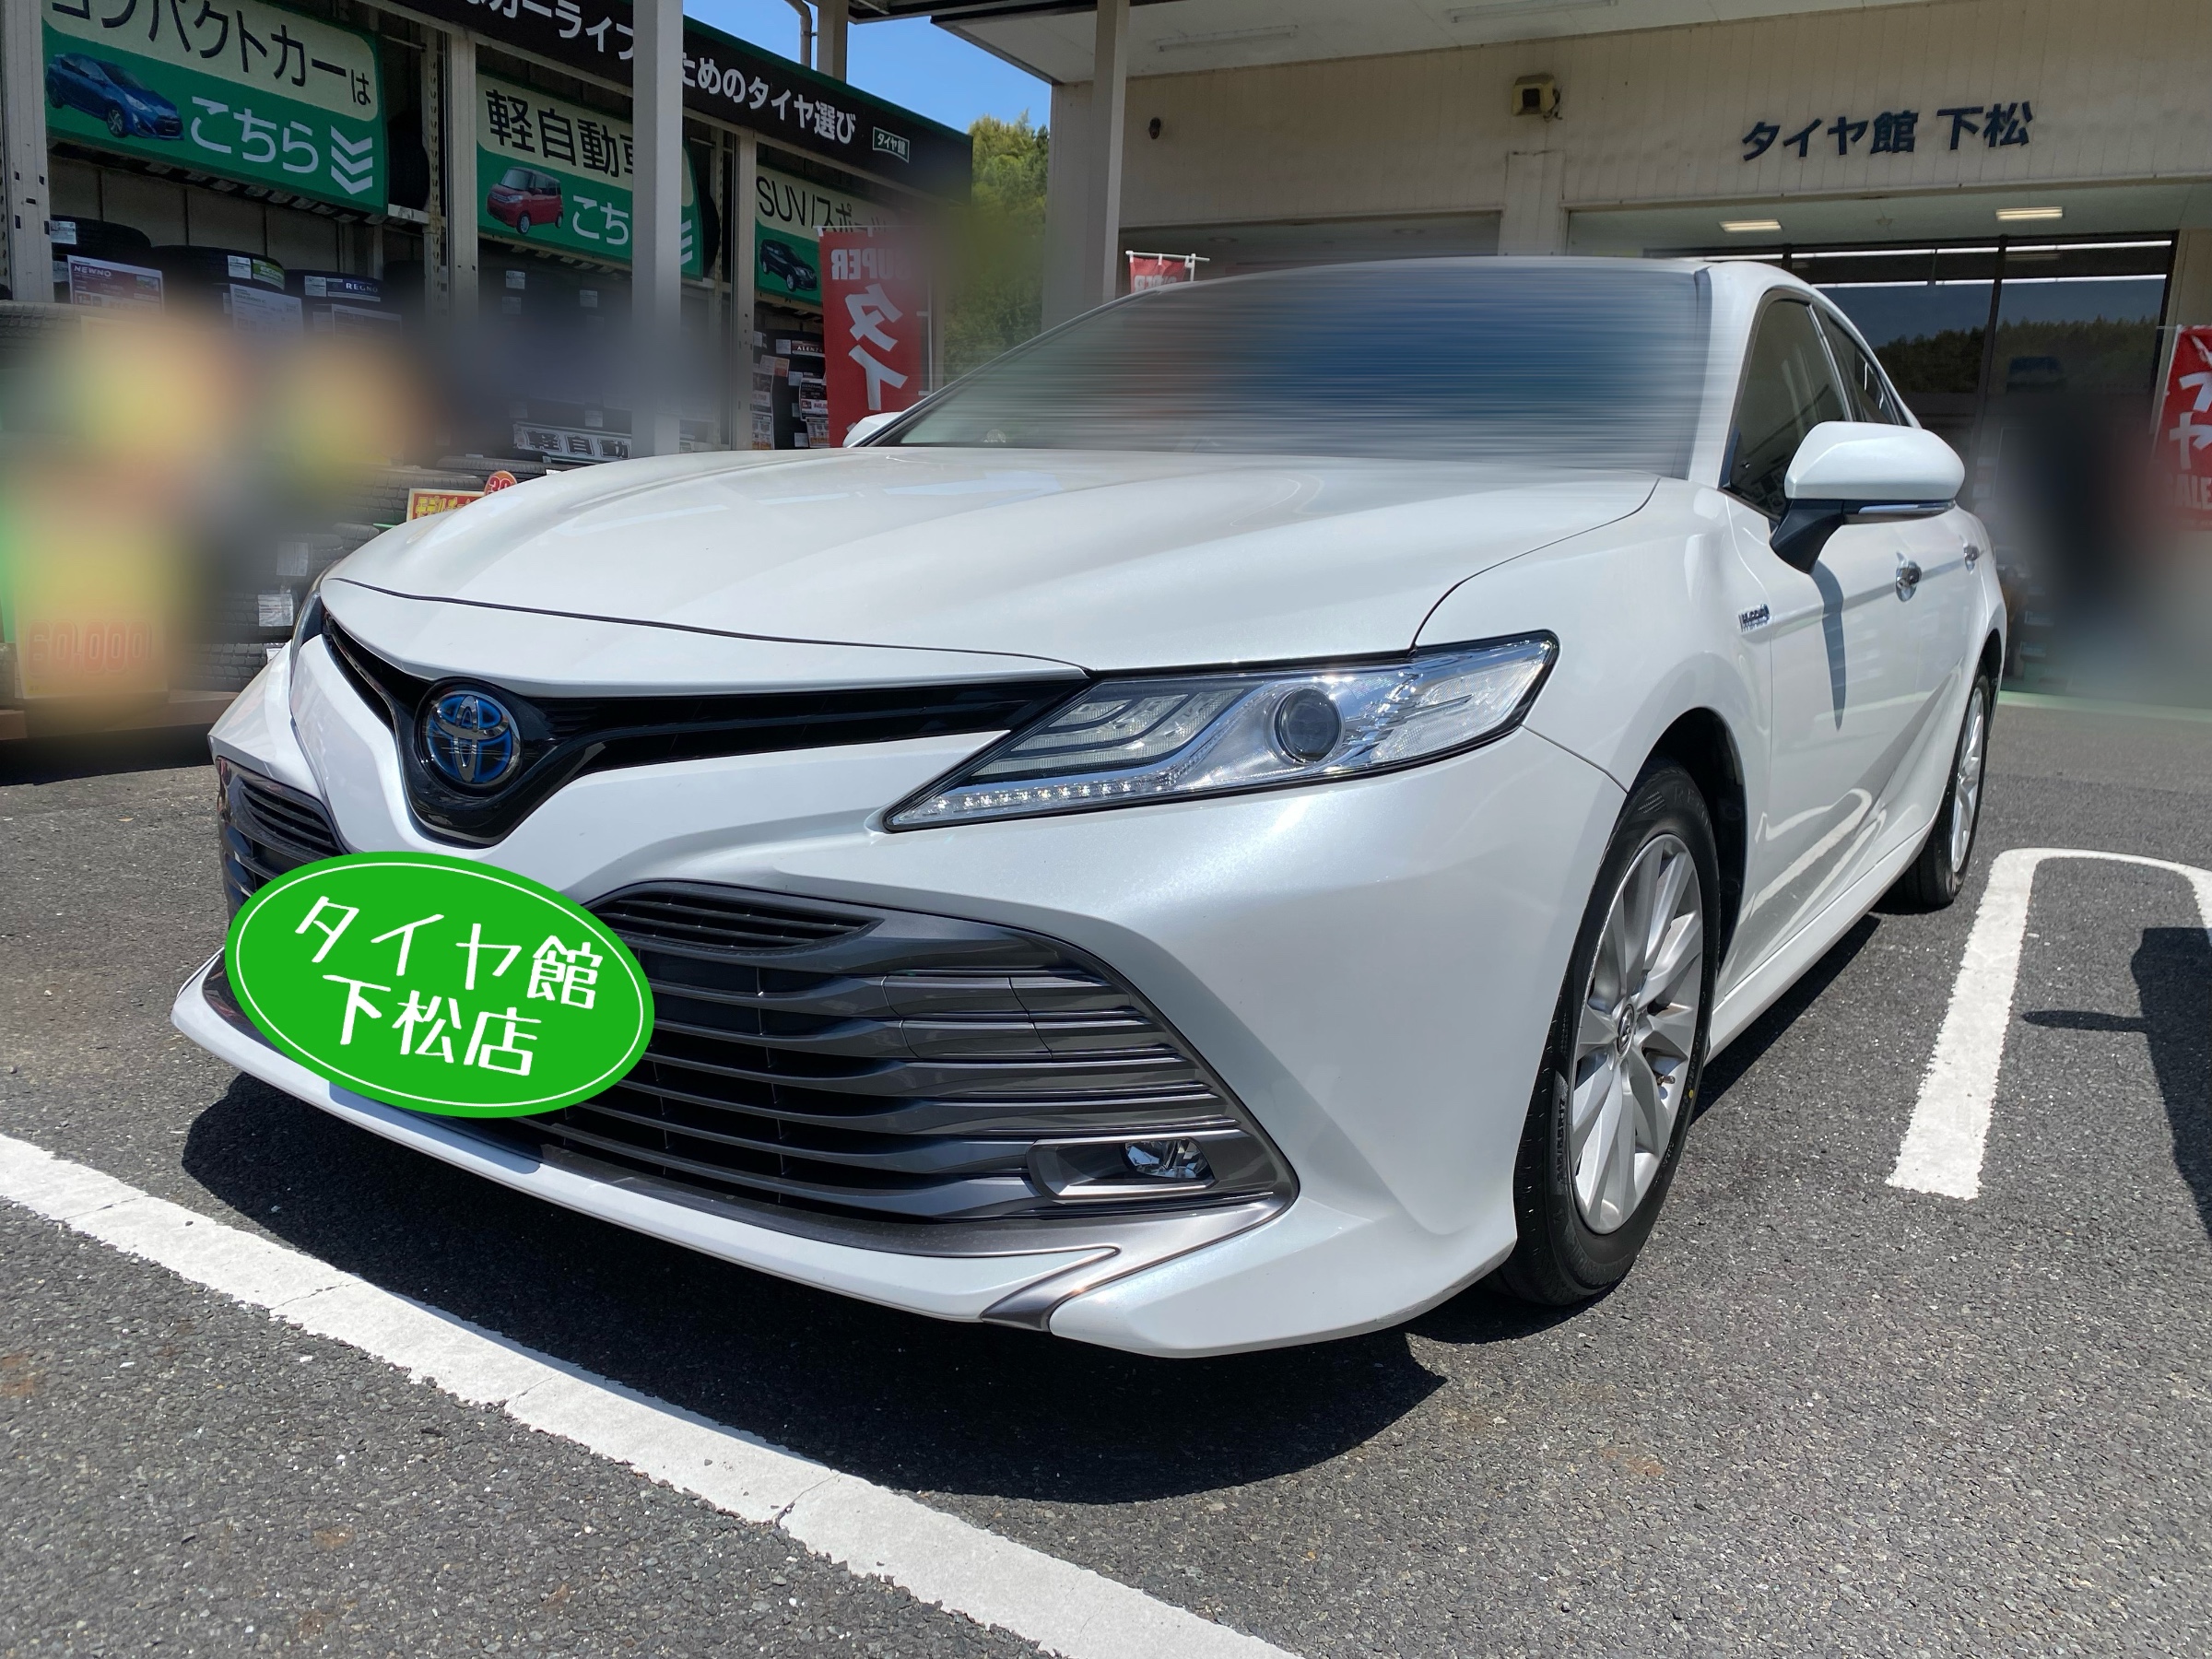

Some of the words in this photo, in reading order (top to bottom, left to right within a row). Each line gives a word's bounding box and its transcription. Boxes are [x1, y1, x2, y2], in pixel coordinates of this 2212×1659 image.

[190, 96, 319, 173] こちら
[877, 133, 906, 156] タイヤ館
[1742, 110, 1919, 161] タイヤ館
[1936, 100, 2032, 150] 下松
[346, 282, 379, 293] REGNO
